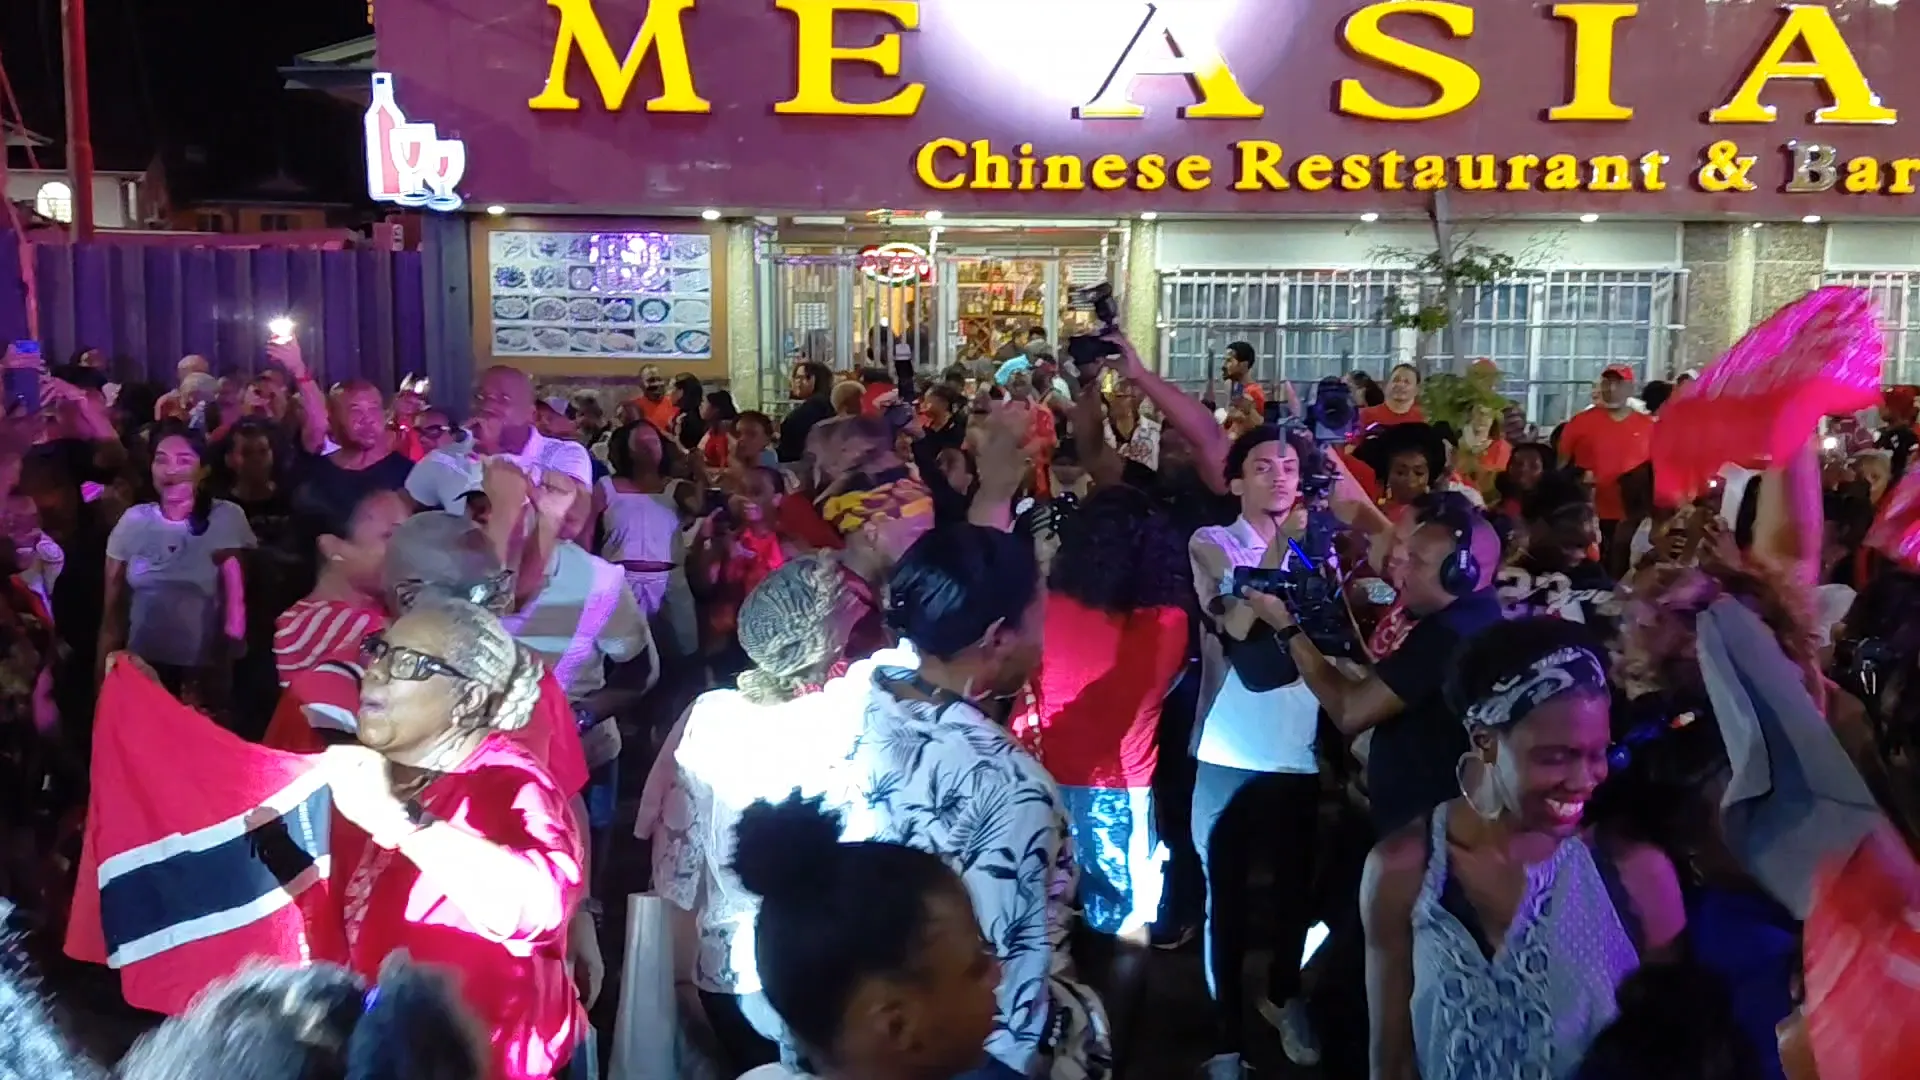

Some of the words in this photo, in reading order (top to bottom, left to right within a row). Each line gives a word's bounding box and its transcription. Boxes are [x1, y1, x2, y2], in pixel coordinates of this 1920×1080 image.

[1074, 0, 1898, 125] ASIA
[915, 137, 1212, 191] Chinese
[1234, 140, 1670, 192] Restaurant
[1697, 140, 1758, 192] &
[1785, 140, 1920, 194] Bar
